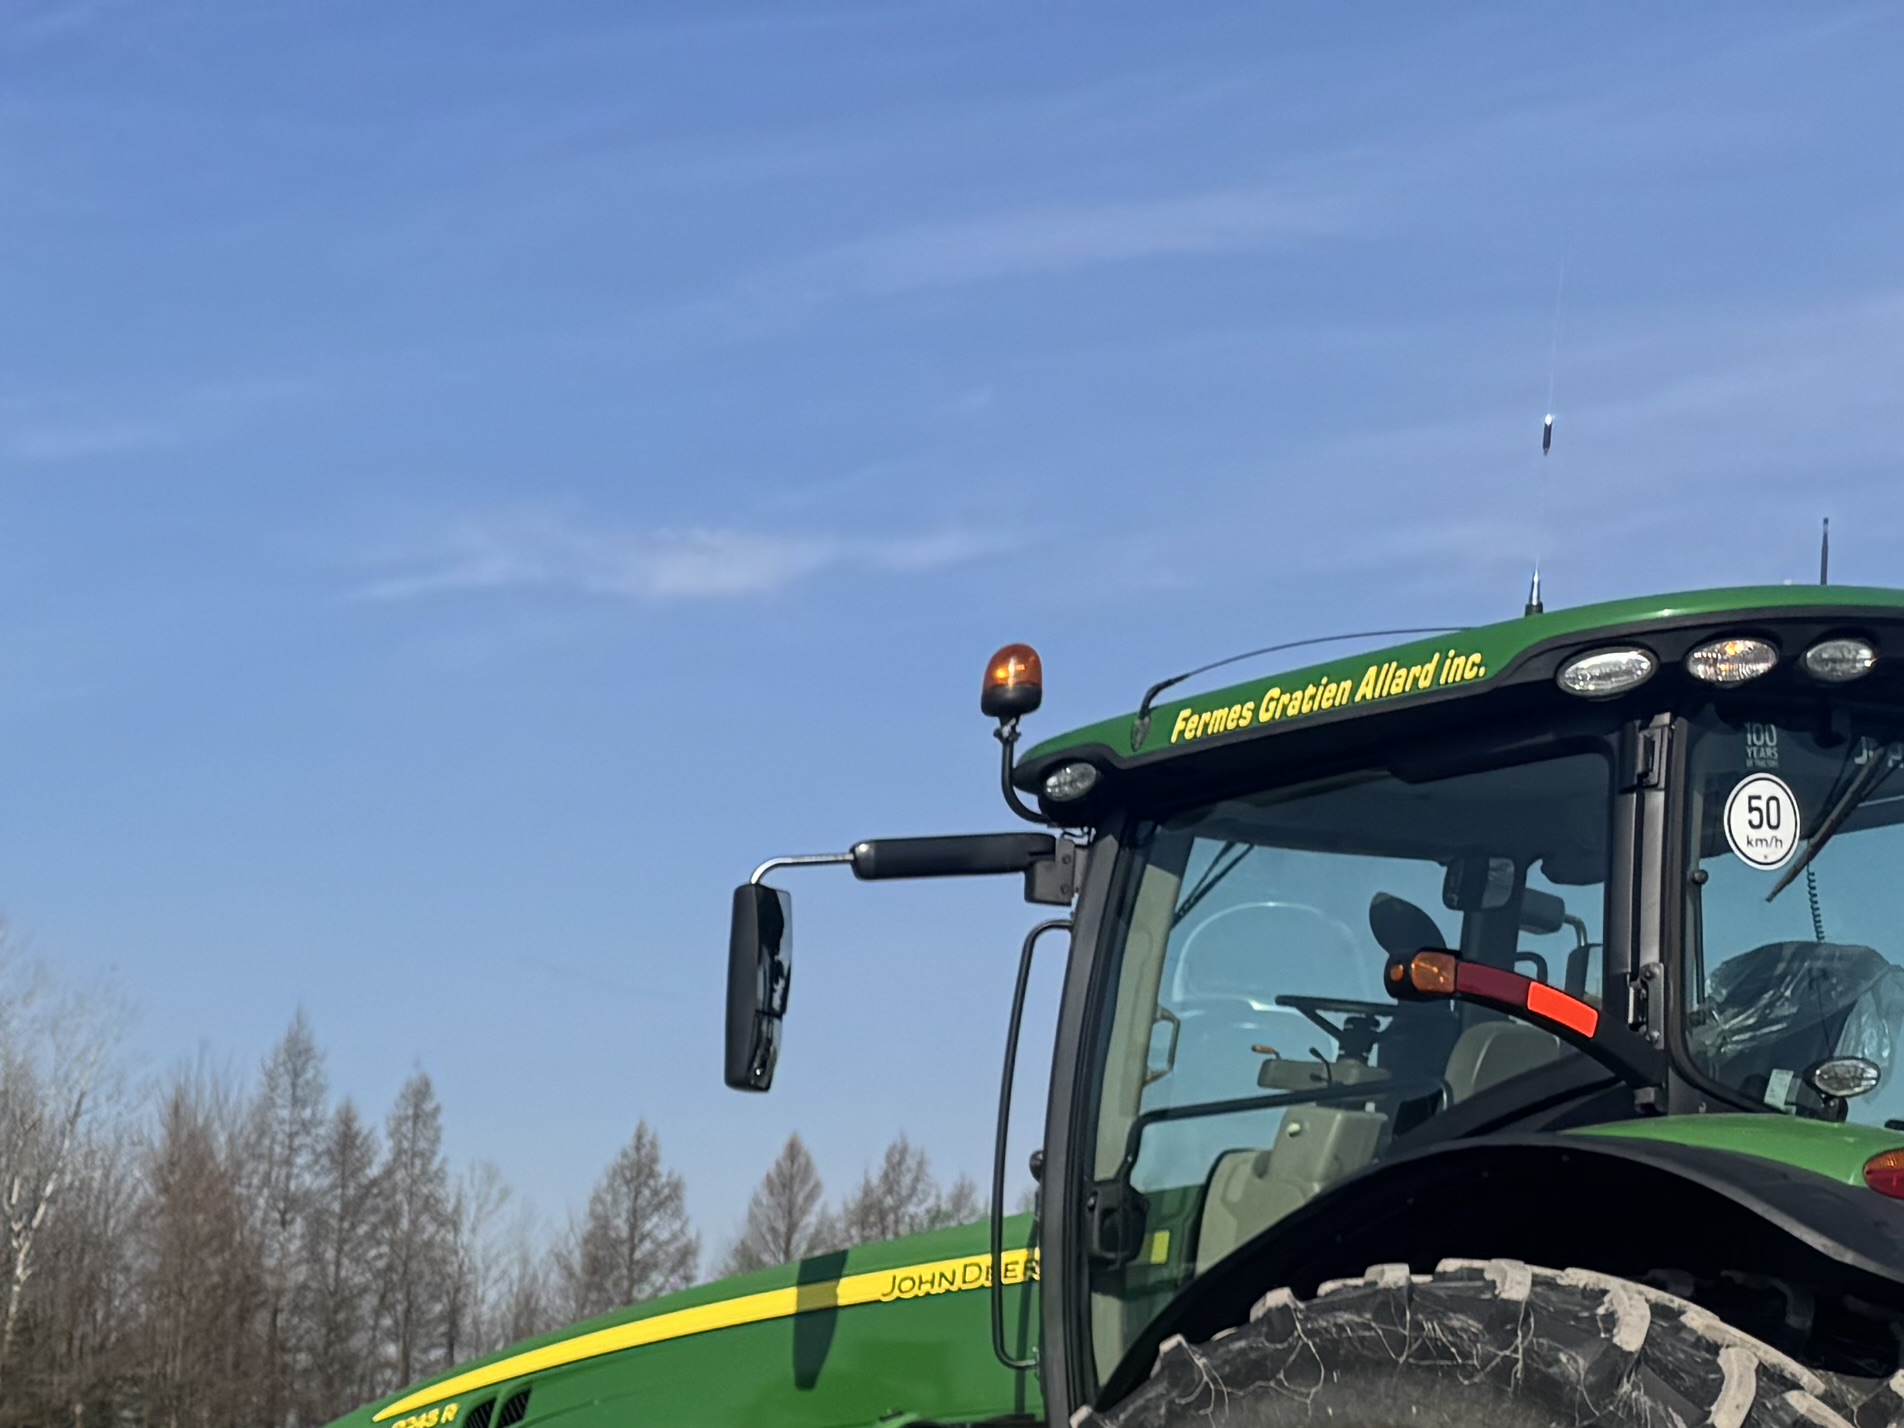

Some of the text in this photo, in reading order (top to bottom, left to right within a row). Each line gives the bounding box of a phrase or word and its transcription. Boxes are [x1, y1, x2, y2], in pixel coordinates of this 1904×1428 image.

[1170, 649, 1486, 743] Fermes Gratien Allard inc.
[1747, 795, 1781, 830] 50
[1746, 835, 1783, 849] km/h
[881, 1269, 957, 1297] JOHN
